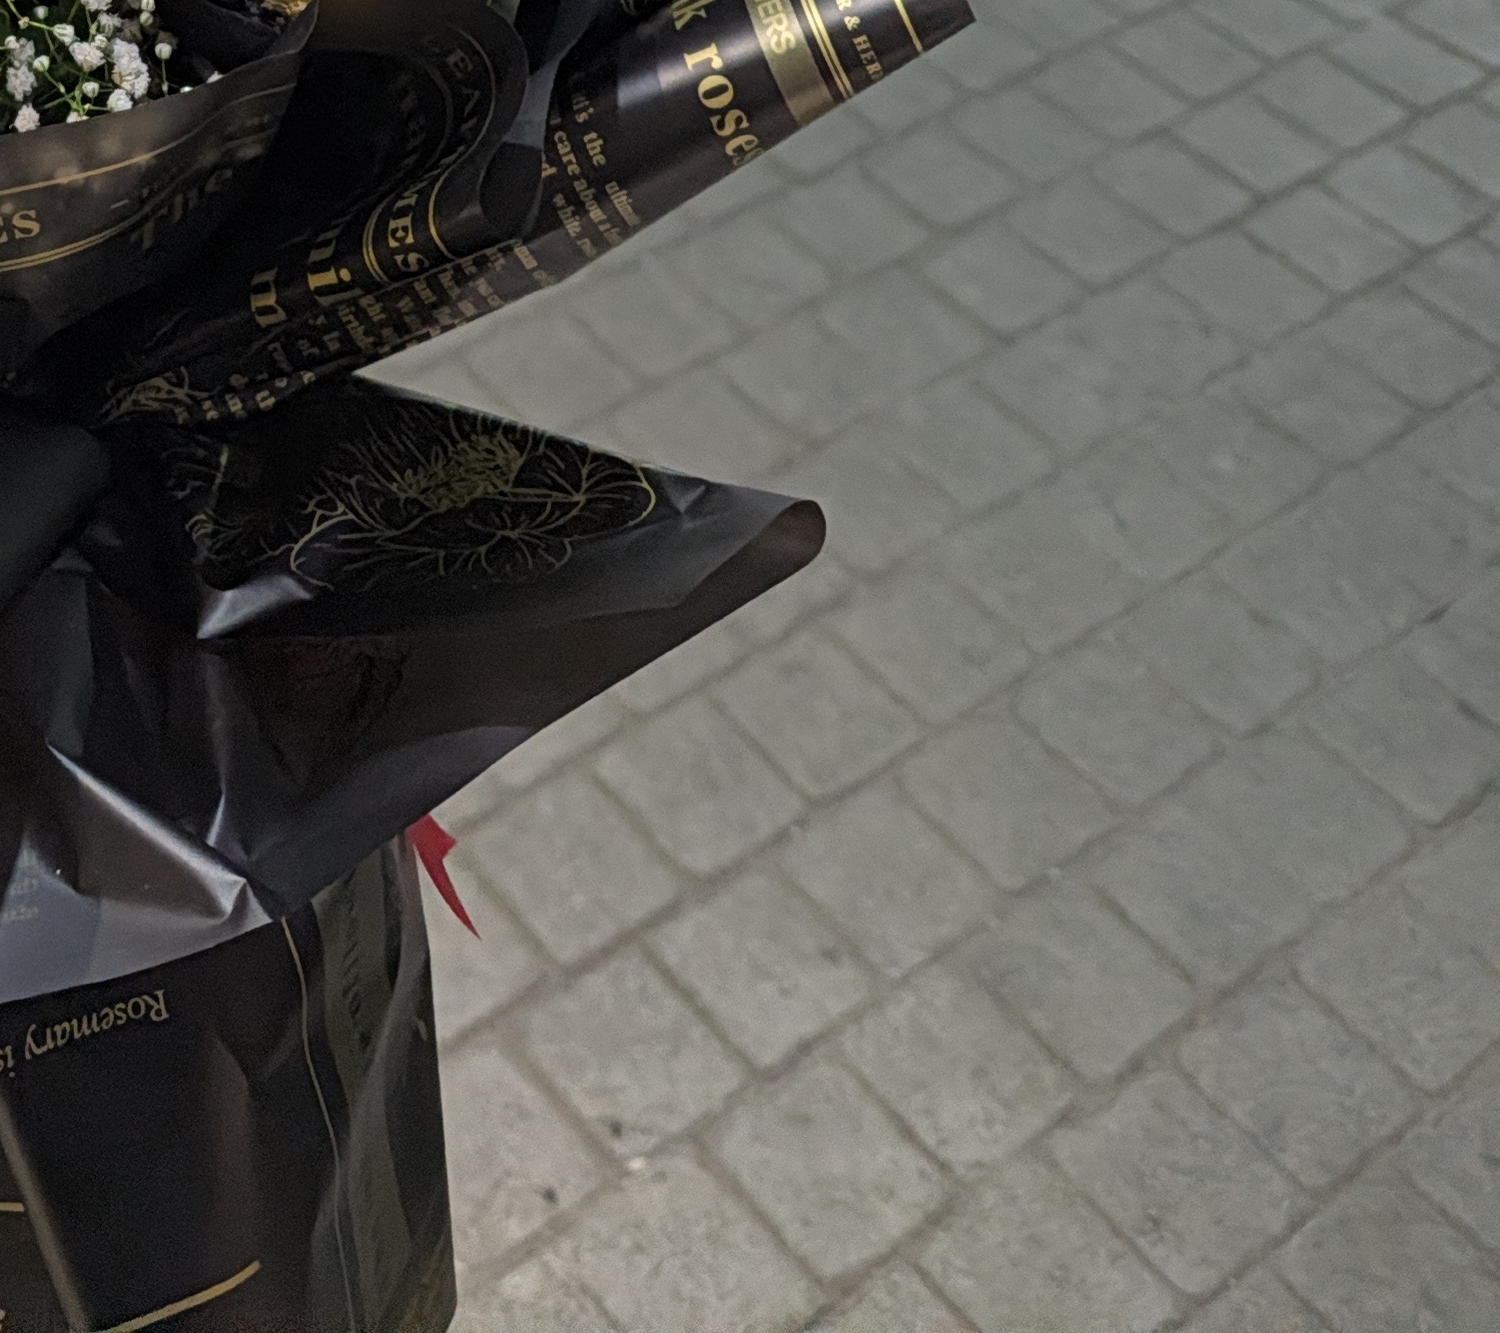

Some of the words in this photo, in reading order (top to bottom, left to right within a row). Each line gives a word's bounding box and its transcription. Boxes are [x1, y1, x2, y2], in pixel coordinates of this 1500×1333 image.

[843, 15, 860, 31] &
[553, 130, 580, 175] care
[582, 131, 606, 166] the
[24, 988, 169, 1060] Rosemary
